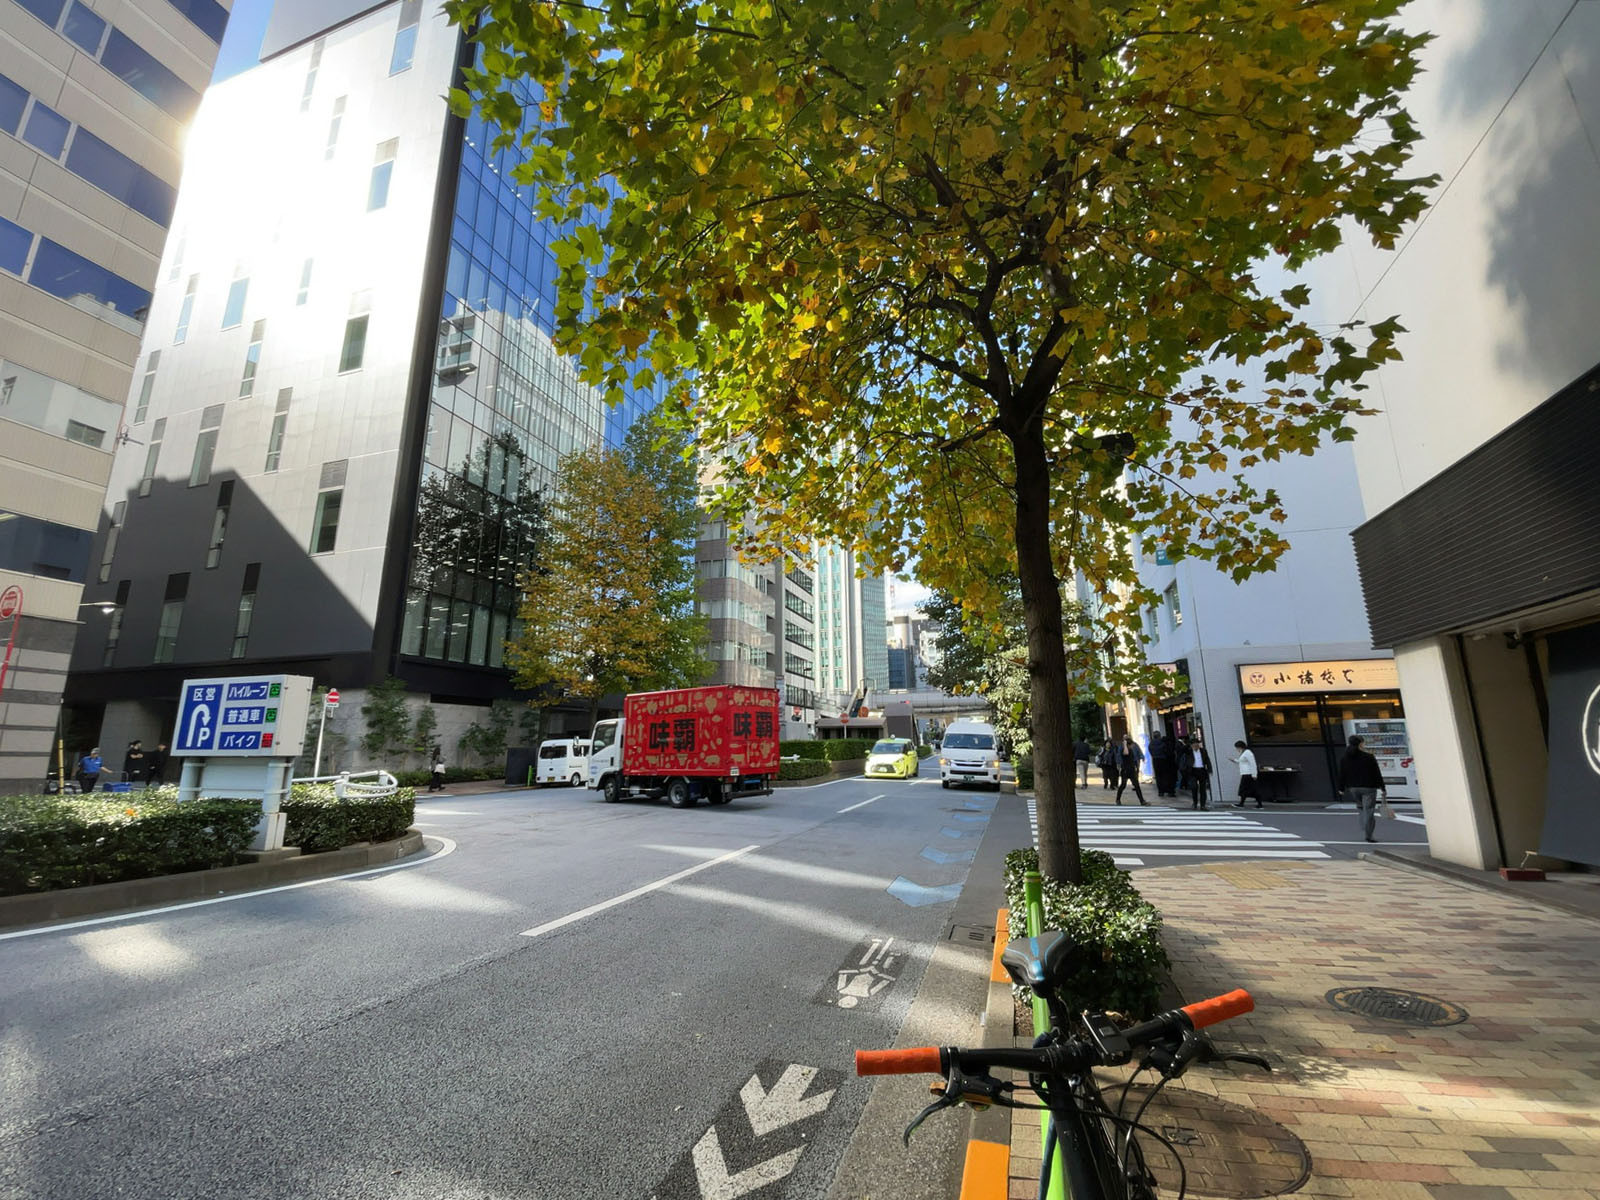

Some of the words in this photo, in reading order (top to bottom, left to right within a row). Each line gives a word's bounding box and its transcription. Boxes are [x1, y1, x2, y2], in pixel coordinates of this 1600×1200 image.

[193, 687, 216, 701] 区営
[229, 685, 267, 698] ハイルーフ
[227, 709, 260, 723] 普通車
[197, 727, 210, 747] P
[224, 734, 256, 748] バイク
